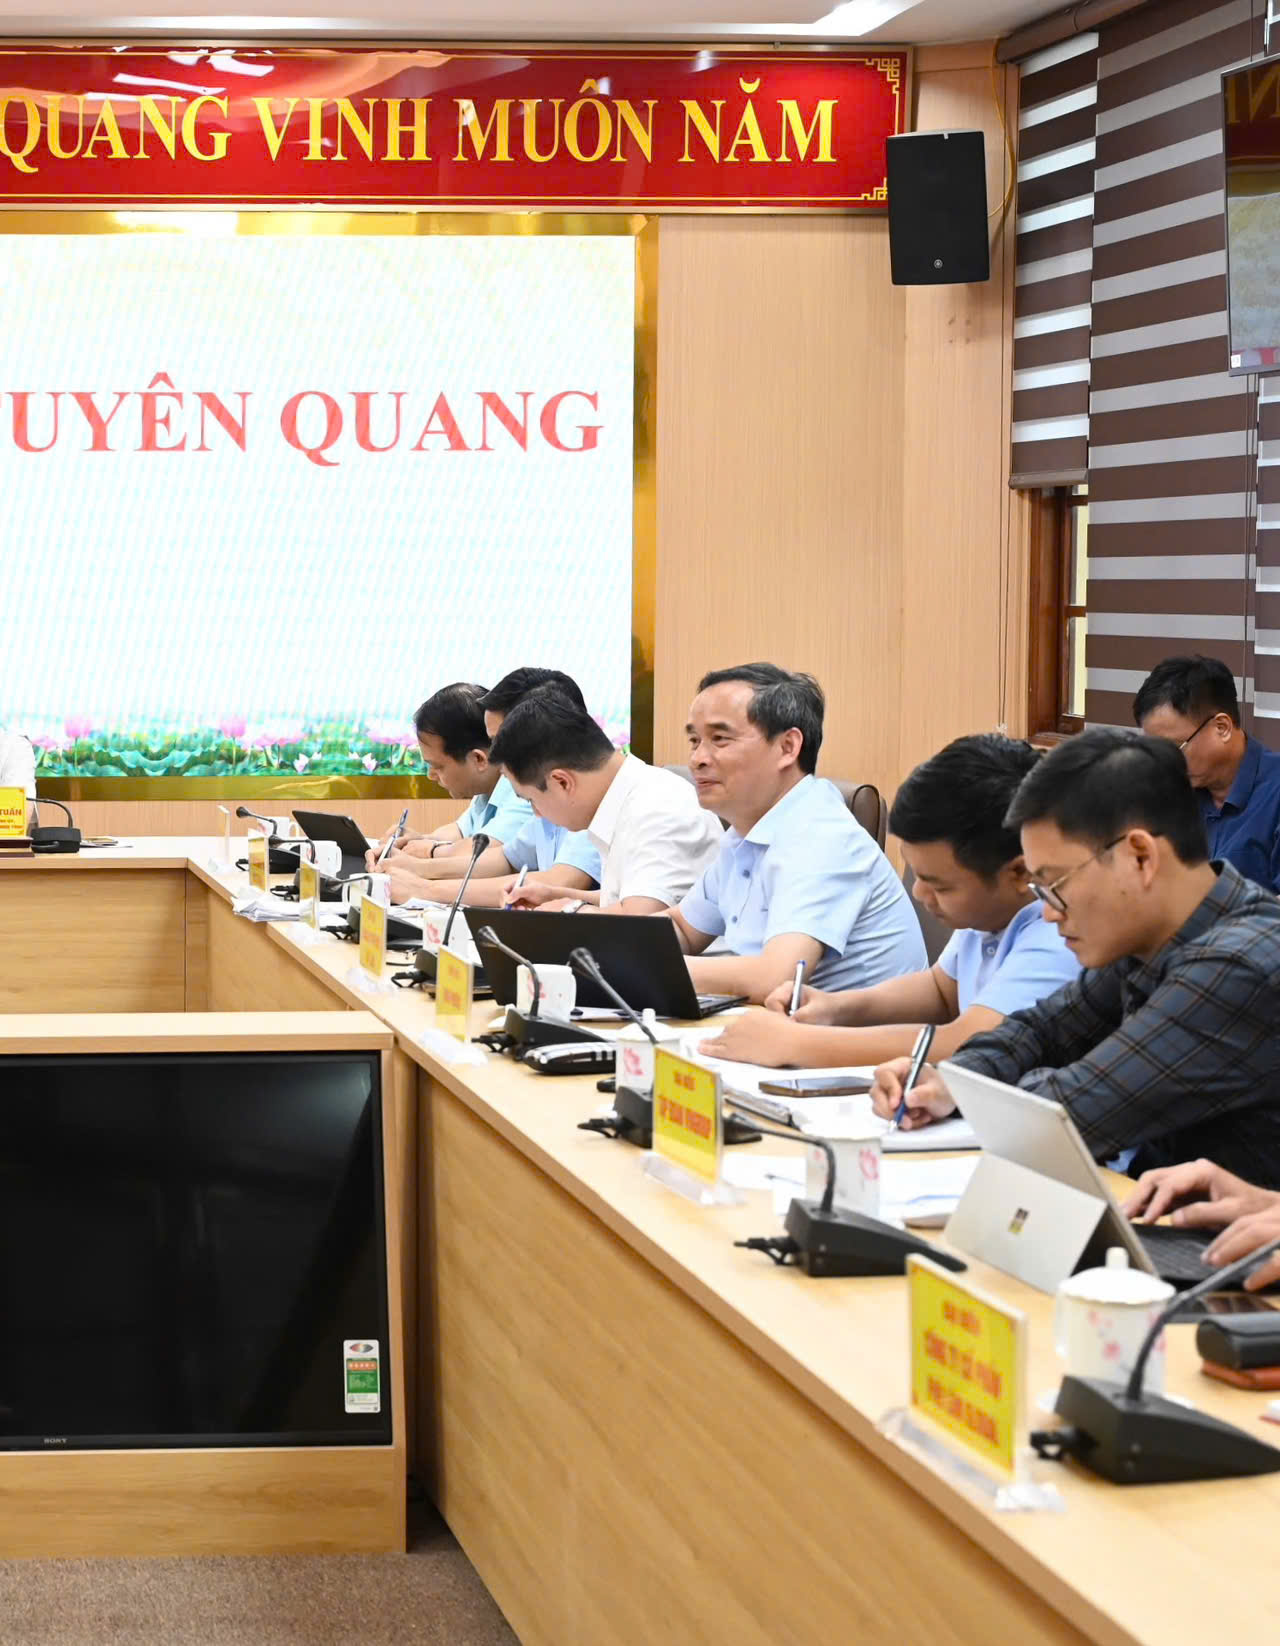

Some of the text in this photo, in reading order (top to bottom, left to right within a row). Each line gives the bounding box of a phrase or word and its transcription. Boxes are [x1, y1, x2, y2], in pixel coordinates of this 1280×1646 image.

[252, 97, 432, 162] VINH
[452, 78, 657, 163] MUÔN
[680, 77, 838, 163] NĂM
[280, 390, 604, 467] QUANG
